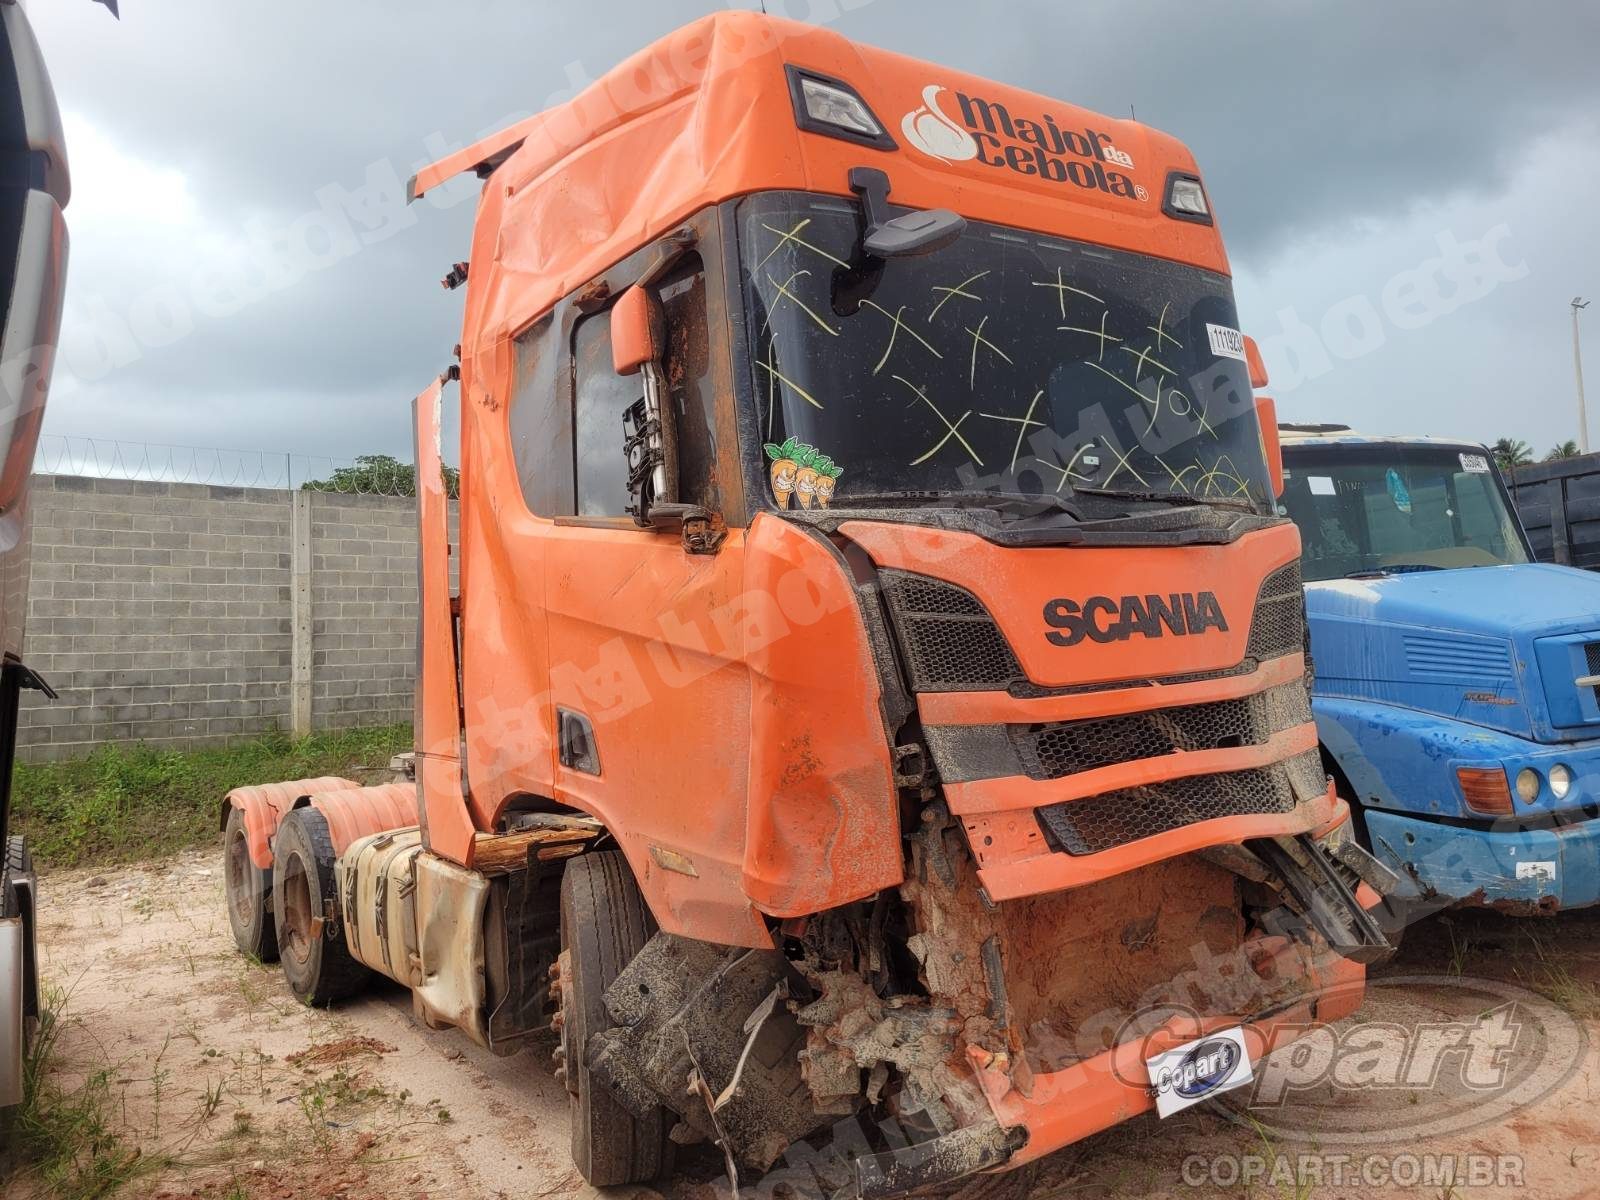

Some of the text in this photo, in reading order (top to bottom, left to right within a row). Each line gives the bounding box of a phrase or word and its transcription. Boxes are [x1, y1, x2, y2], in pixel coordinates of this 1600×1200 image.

[1103, 145, 1134, 169] da
[1043, 591, 1229, 646] SCANIA
[1157, 1042, 1230, 1093] Copart
